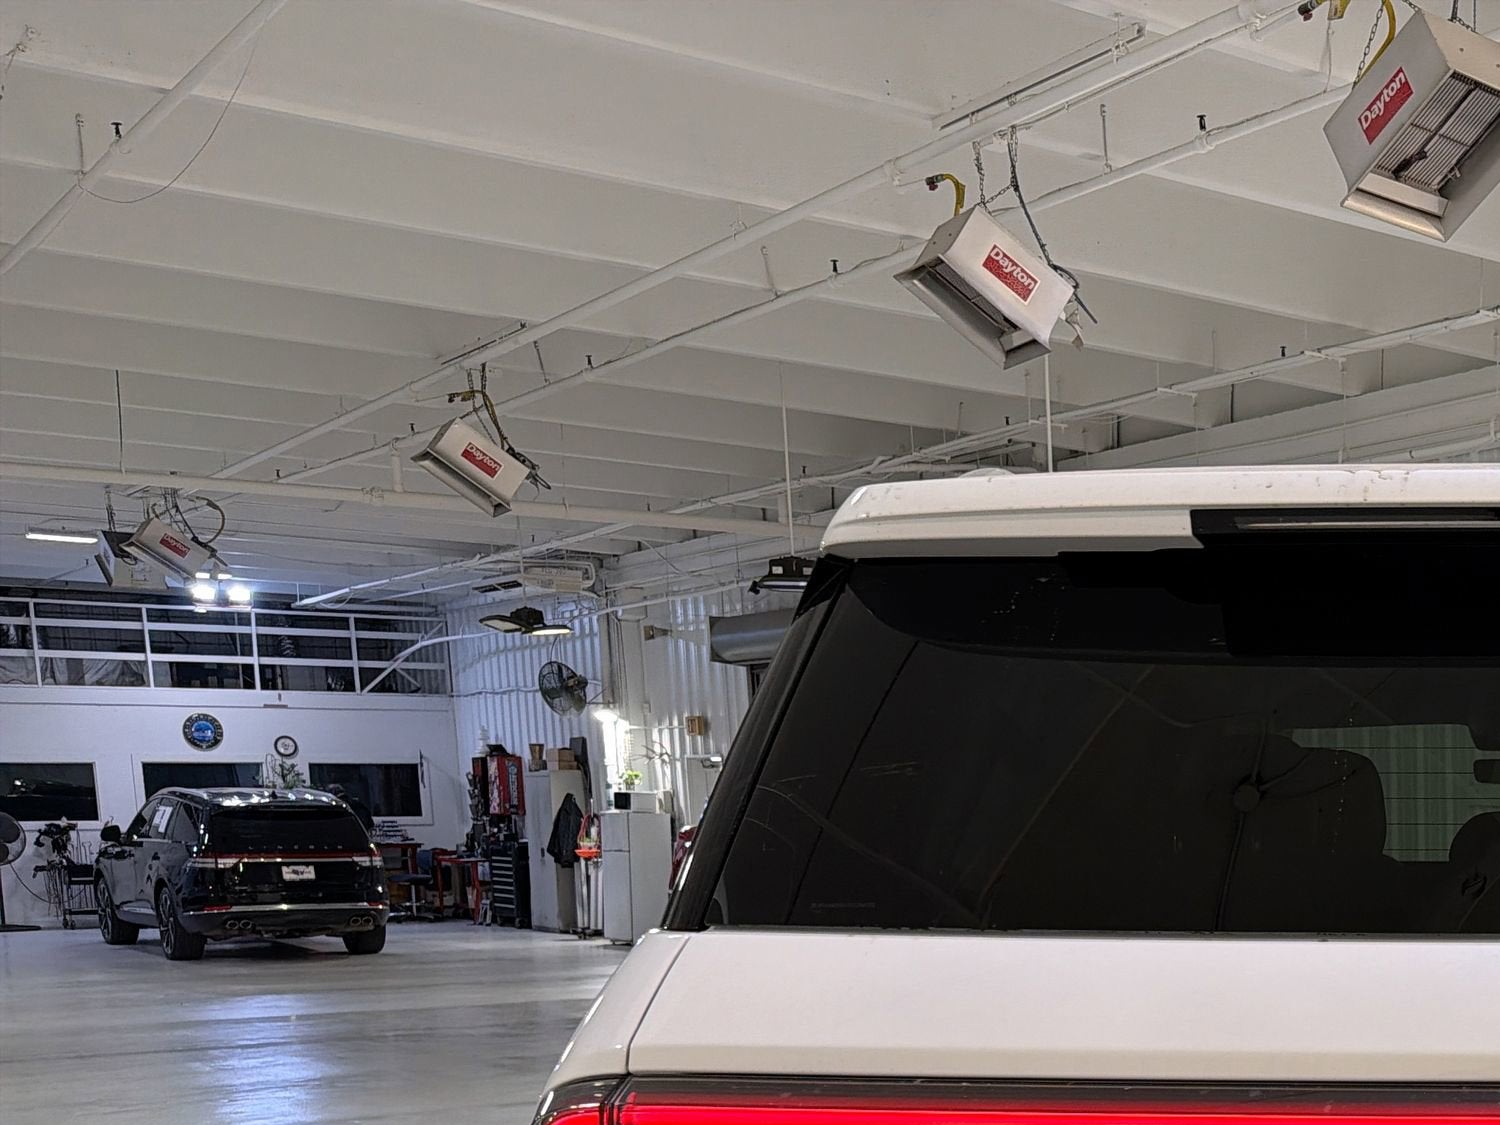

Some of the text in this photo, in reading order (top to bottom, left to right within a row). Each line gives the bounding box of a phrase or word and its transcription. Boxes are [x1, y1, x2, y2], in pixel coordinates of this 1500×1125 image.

[1360, 72, 1406, 129] Dayton
[990, 247, 1035, 289] Dayton
[467, 443, 500, 471] Dayton
[164, 533, 190, 553] Dayton
